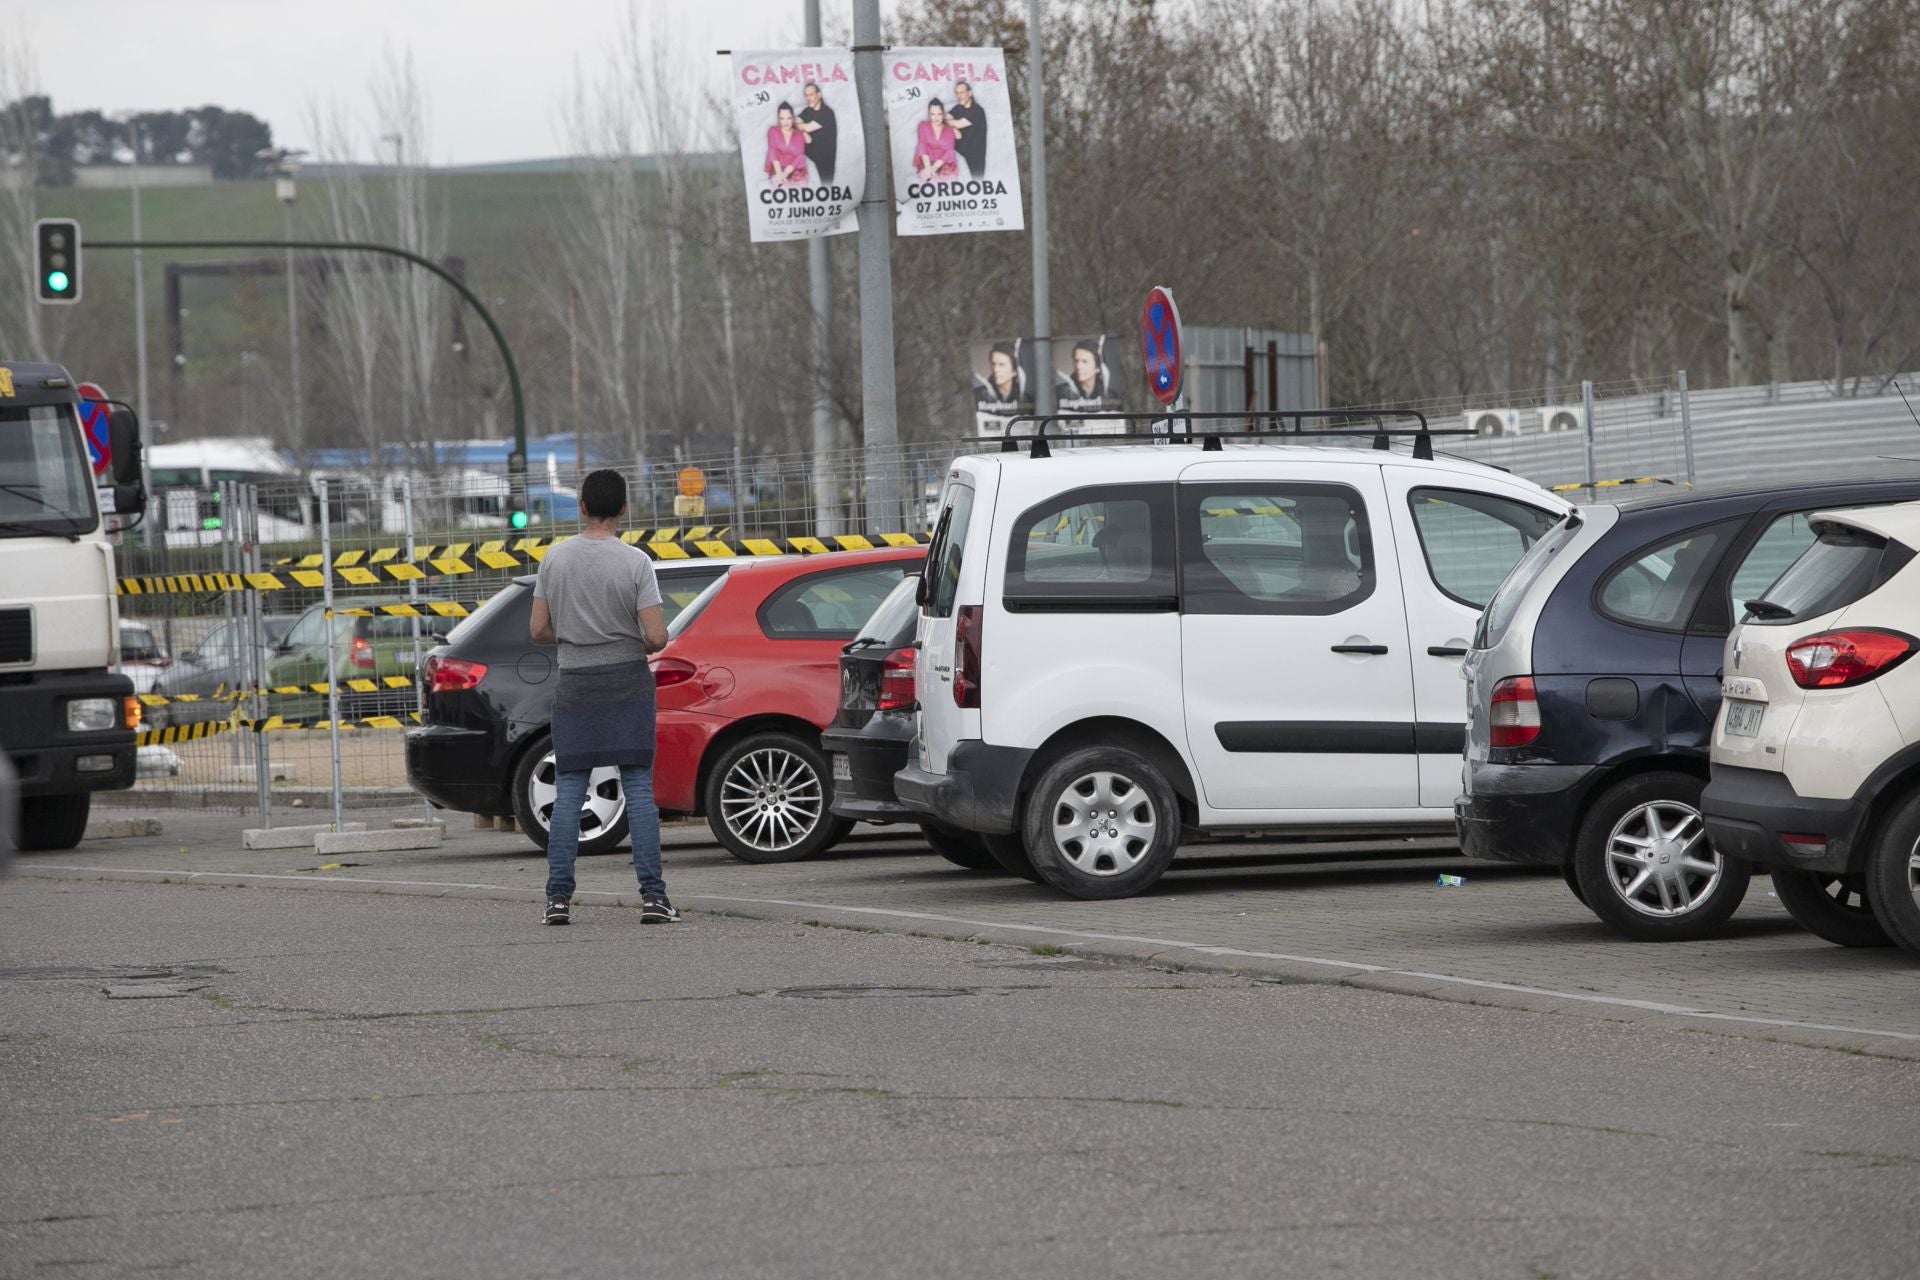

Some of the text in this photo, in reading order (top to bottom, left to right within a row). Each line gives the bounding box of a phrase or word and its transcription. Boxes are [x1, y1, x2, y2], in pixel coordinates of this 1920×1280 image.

[742, 64, 848, 85] CAMELA
[893, 62, 1000, 82] CAMELA
[754, 90, 770, 106] 30
[905, 86, 921, 101] 30
[760, 184, 853, 204] CÓRDOBA
[908, 179, 1007, 199] CÓRDOBA
[768, 204, 842, 219] 07 JUNIO 25
[916, 198, 997, 213] 07 JUNIO 25
